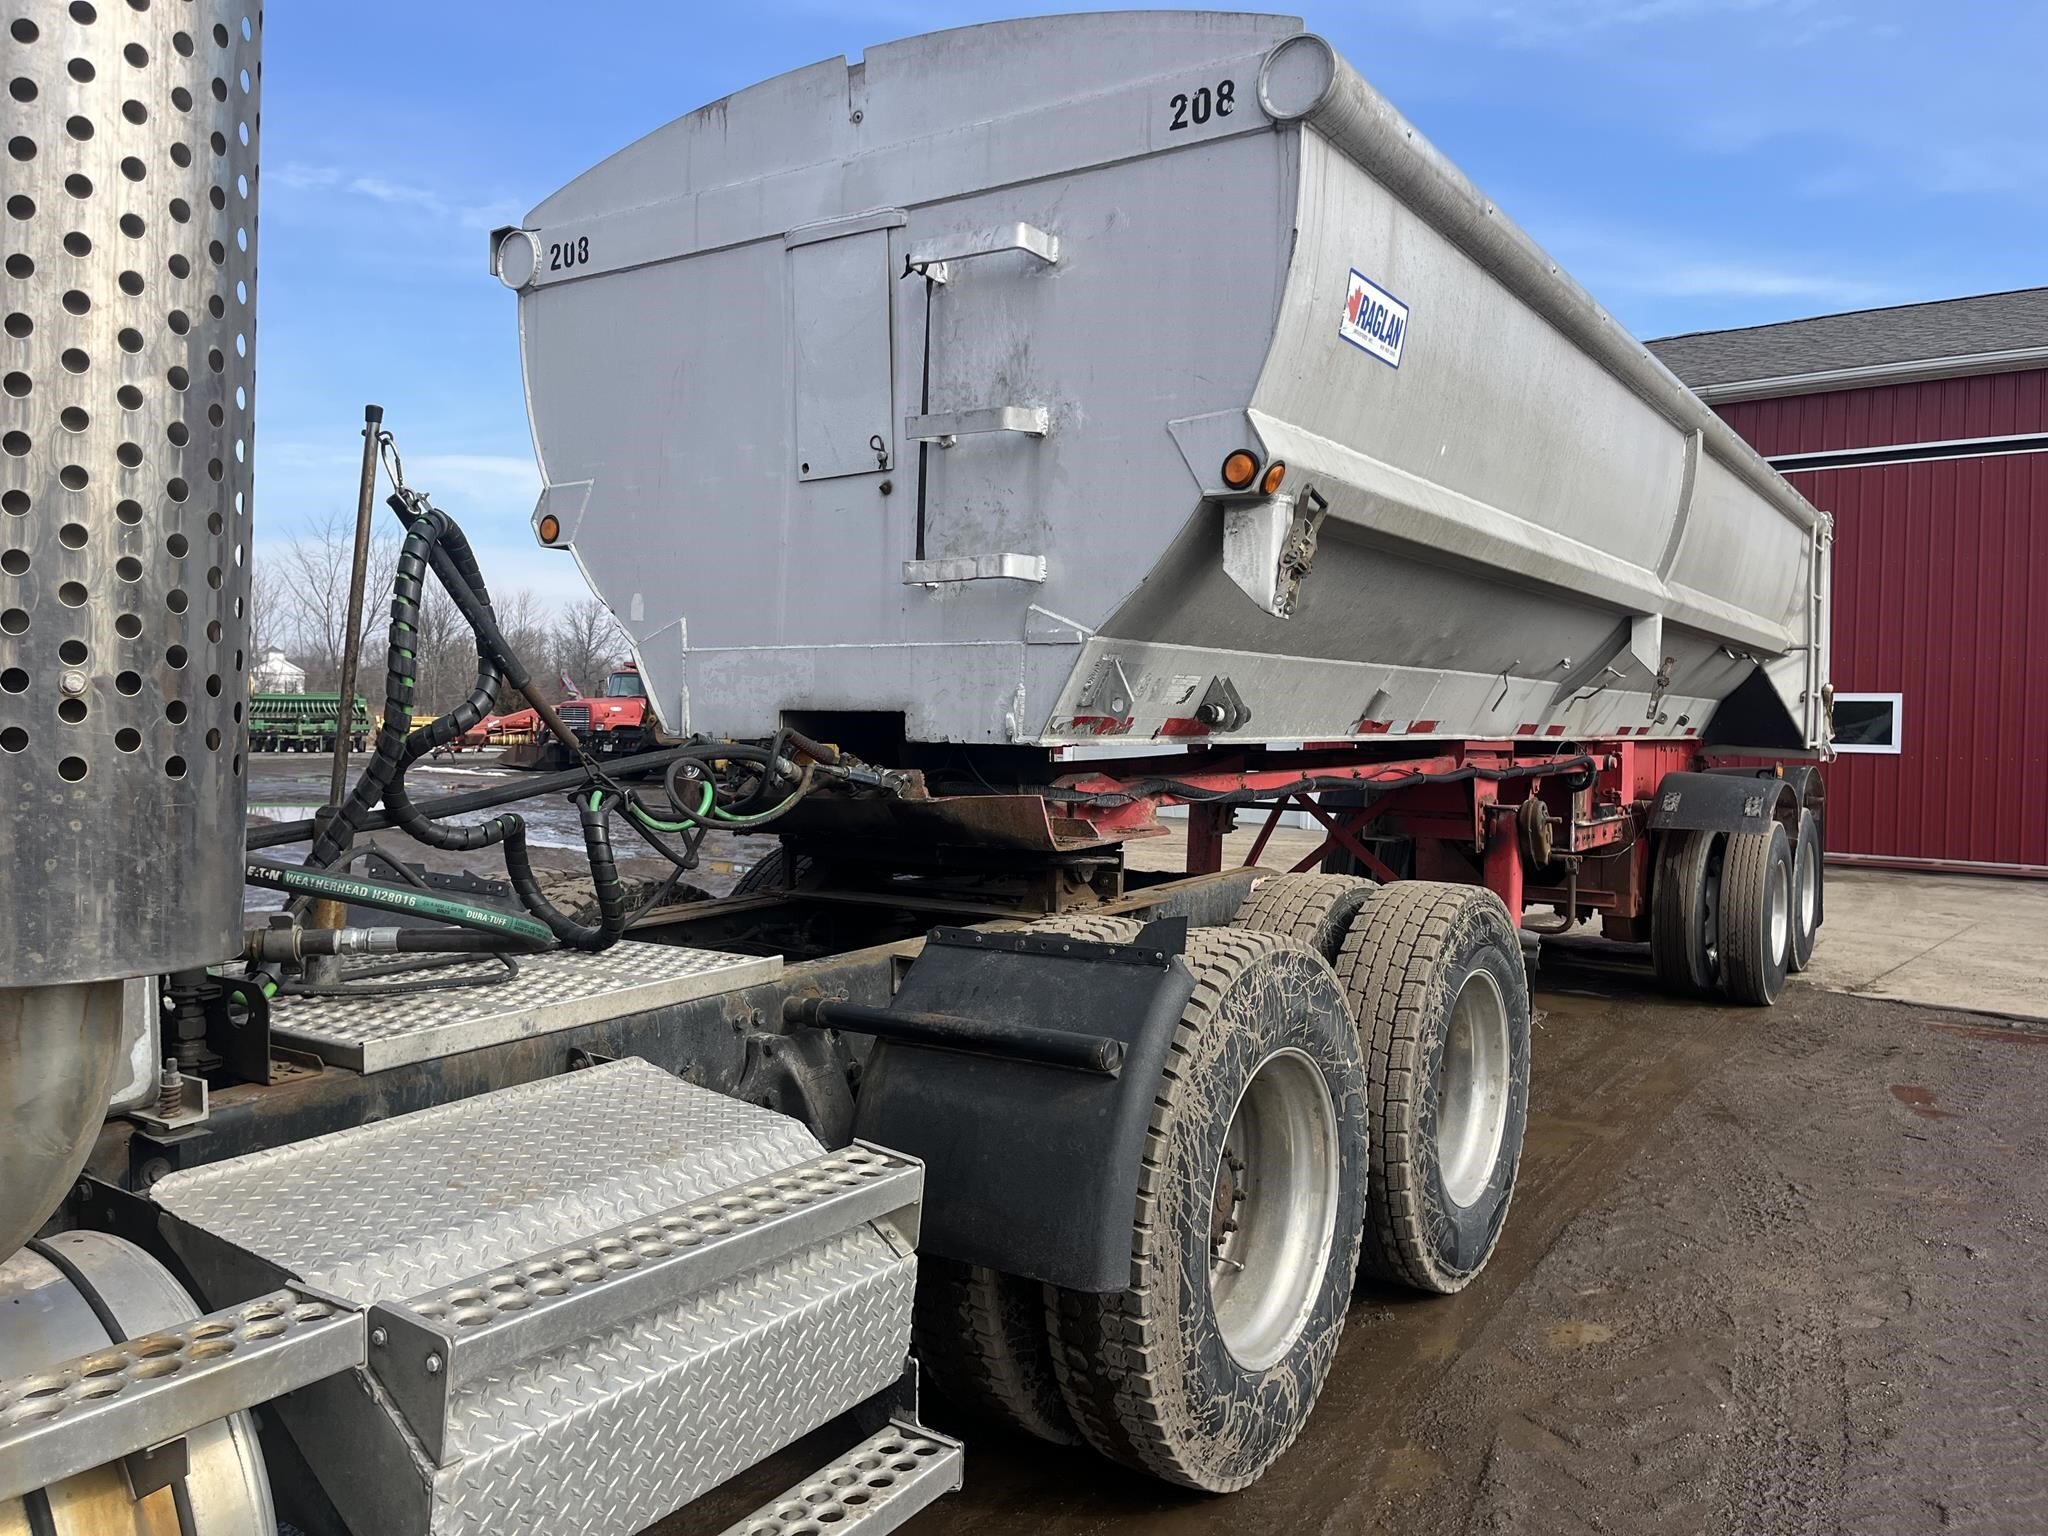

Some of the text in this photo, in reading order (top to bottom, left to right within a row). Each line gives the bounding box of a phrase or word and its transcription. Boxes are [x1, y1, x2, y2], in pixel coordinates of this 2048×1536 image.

[1169, 79, 1235, 131] 208
[550, 236, 589, 271] 208
[1356, 294, 1404, 350] RAGLAN
[286, 872, 368, 897] WEATHERHEAD
[372, 889, 417, 907] H28016
